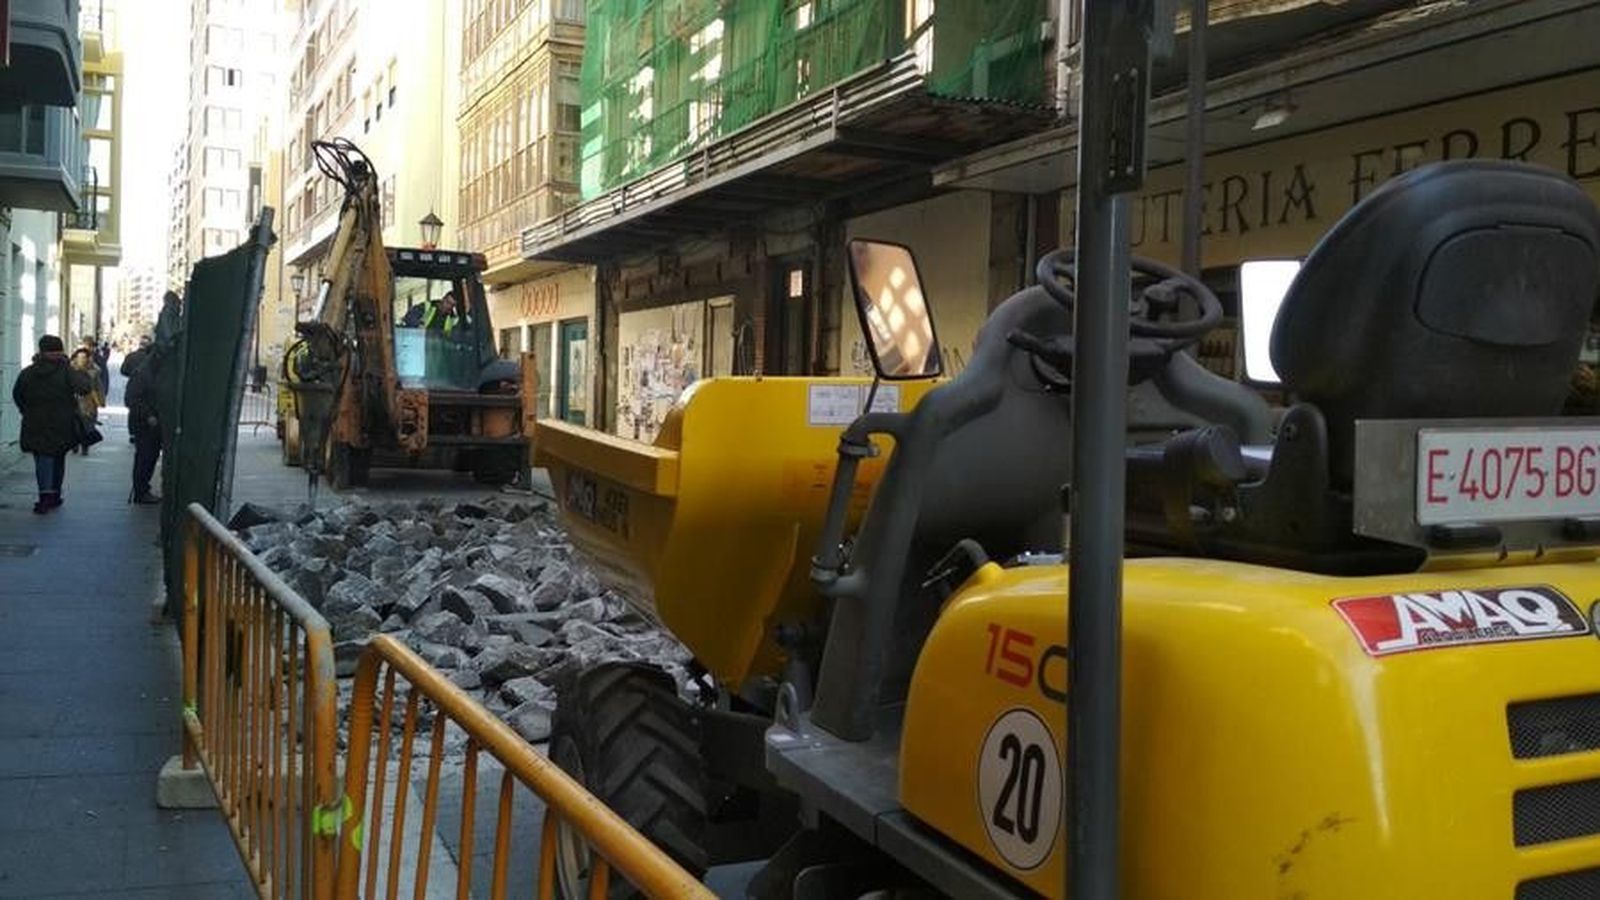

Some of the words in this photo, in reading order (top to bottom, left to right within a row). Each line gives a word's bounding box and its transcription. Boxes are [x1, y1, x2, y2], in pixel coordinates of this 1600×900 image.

[1426, 449, 1449, 503] E
[1458, 447, 1545, 500] 4075
[1555, 445, 1600, 498] BG
[1376, 589, 1575, 650] AMAQ
[993, 732, 1046, 844] 20
